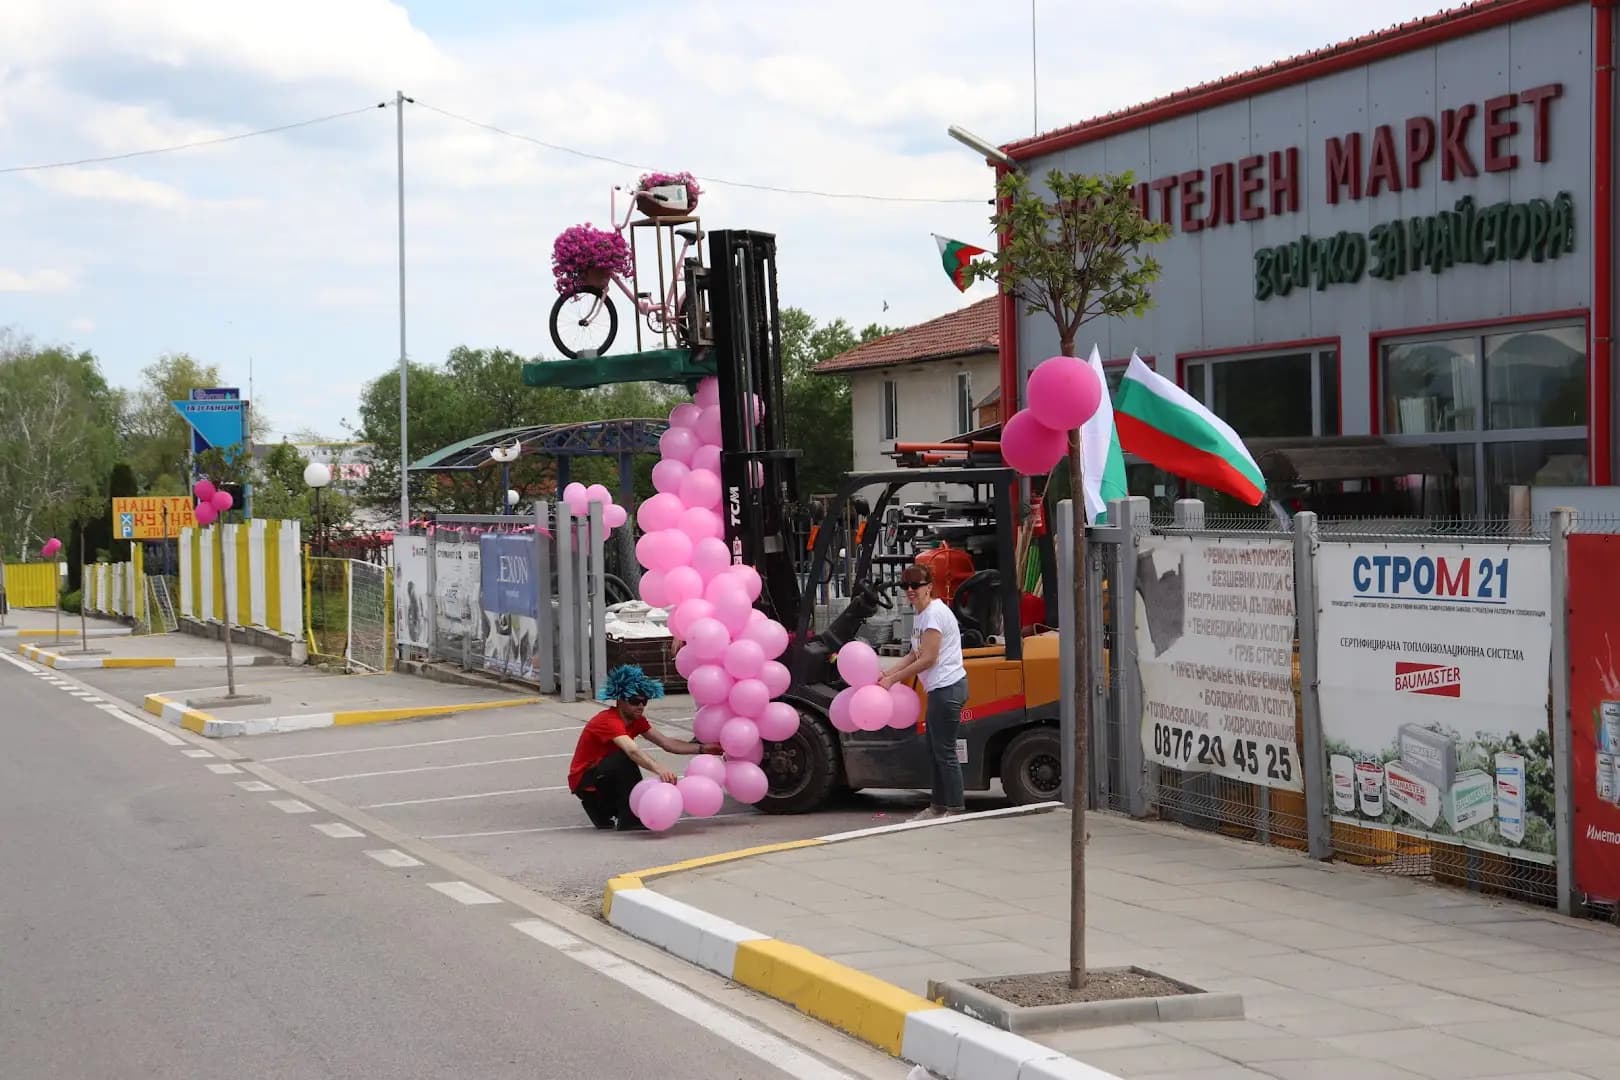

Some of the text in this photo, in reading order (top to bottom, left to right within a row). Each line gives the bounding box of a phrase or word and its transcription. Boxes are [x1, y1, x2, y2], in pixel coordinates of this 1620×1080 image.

[1325, 82, 1566, 206] МАРКЕТ
[1253, 191, 1575, 301] ВСИЧКО ЗА МАЙСТОРА
[729, 486, 741, 527] TCM
[1353, 555, 1509, 598] СТРОМ 21
[1340, 637, 1524, 661] СЕРТИФИЦИРАНА ТОПЛОИЗОЛАЦИОННА СИСТЕМА
[1395, 666, 1461, 691] BAUMASTER
[1155, 723, 1193, 762] 0876
[1233, 739, 1258, 775] 45
[1265, 744, 1291, 781] 25
